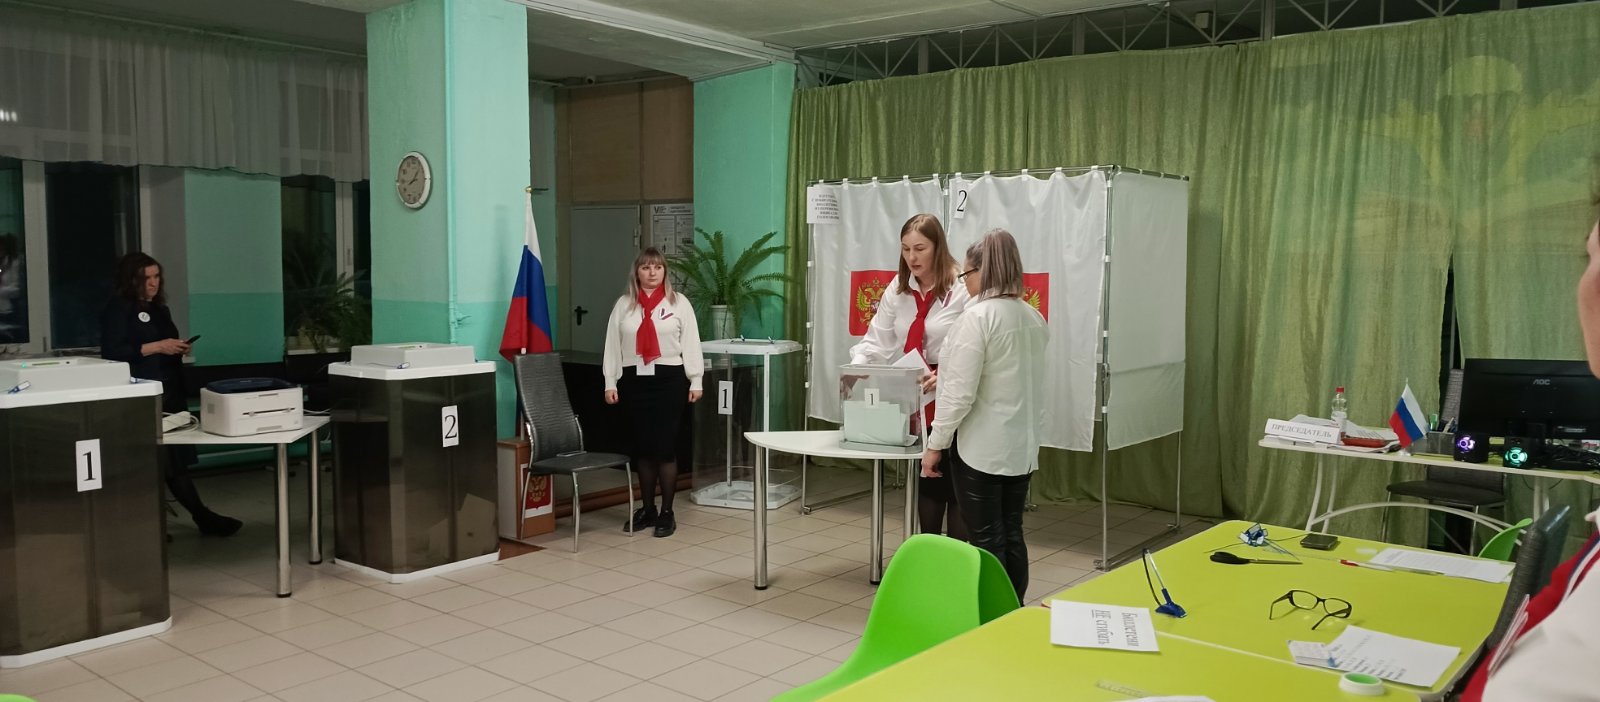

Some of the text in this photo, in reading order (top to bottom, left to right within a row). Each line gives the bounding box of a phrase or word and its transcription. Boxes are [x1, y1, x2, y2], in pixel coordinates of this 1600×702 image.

[957, 190, 967, 211] 2
[1532, 378, 1551, 386] AOC
[722, 388, 728, 409] 1
[870, 394, 874, 406] 1
[444, 414, 457, 439] 2
[1271, 423, 1332, 438] ПРЕДСЕДАТЕЛЬ
[83, 450, 96, 481] 1
[1095, 609, 1114, 645] НЕ сгибать
[1121, 612, 1139, 647] Бюллетени
